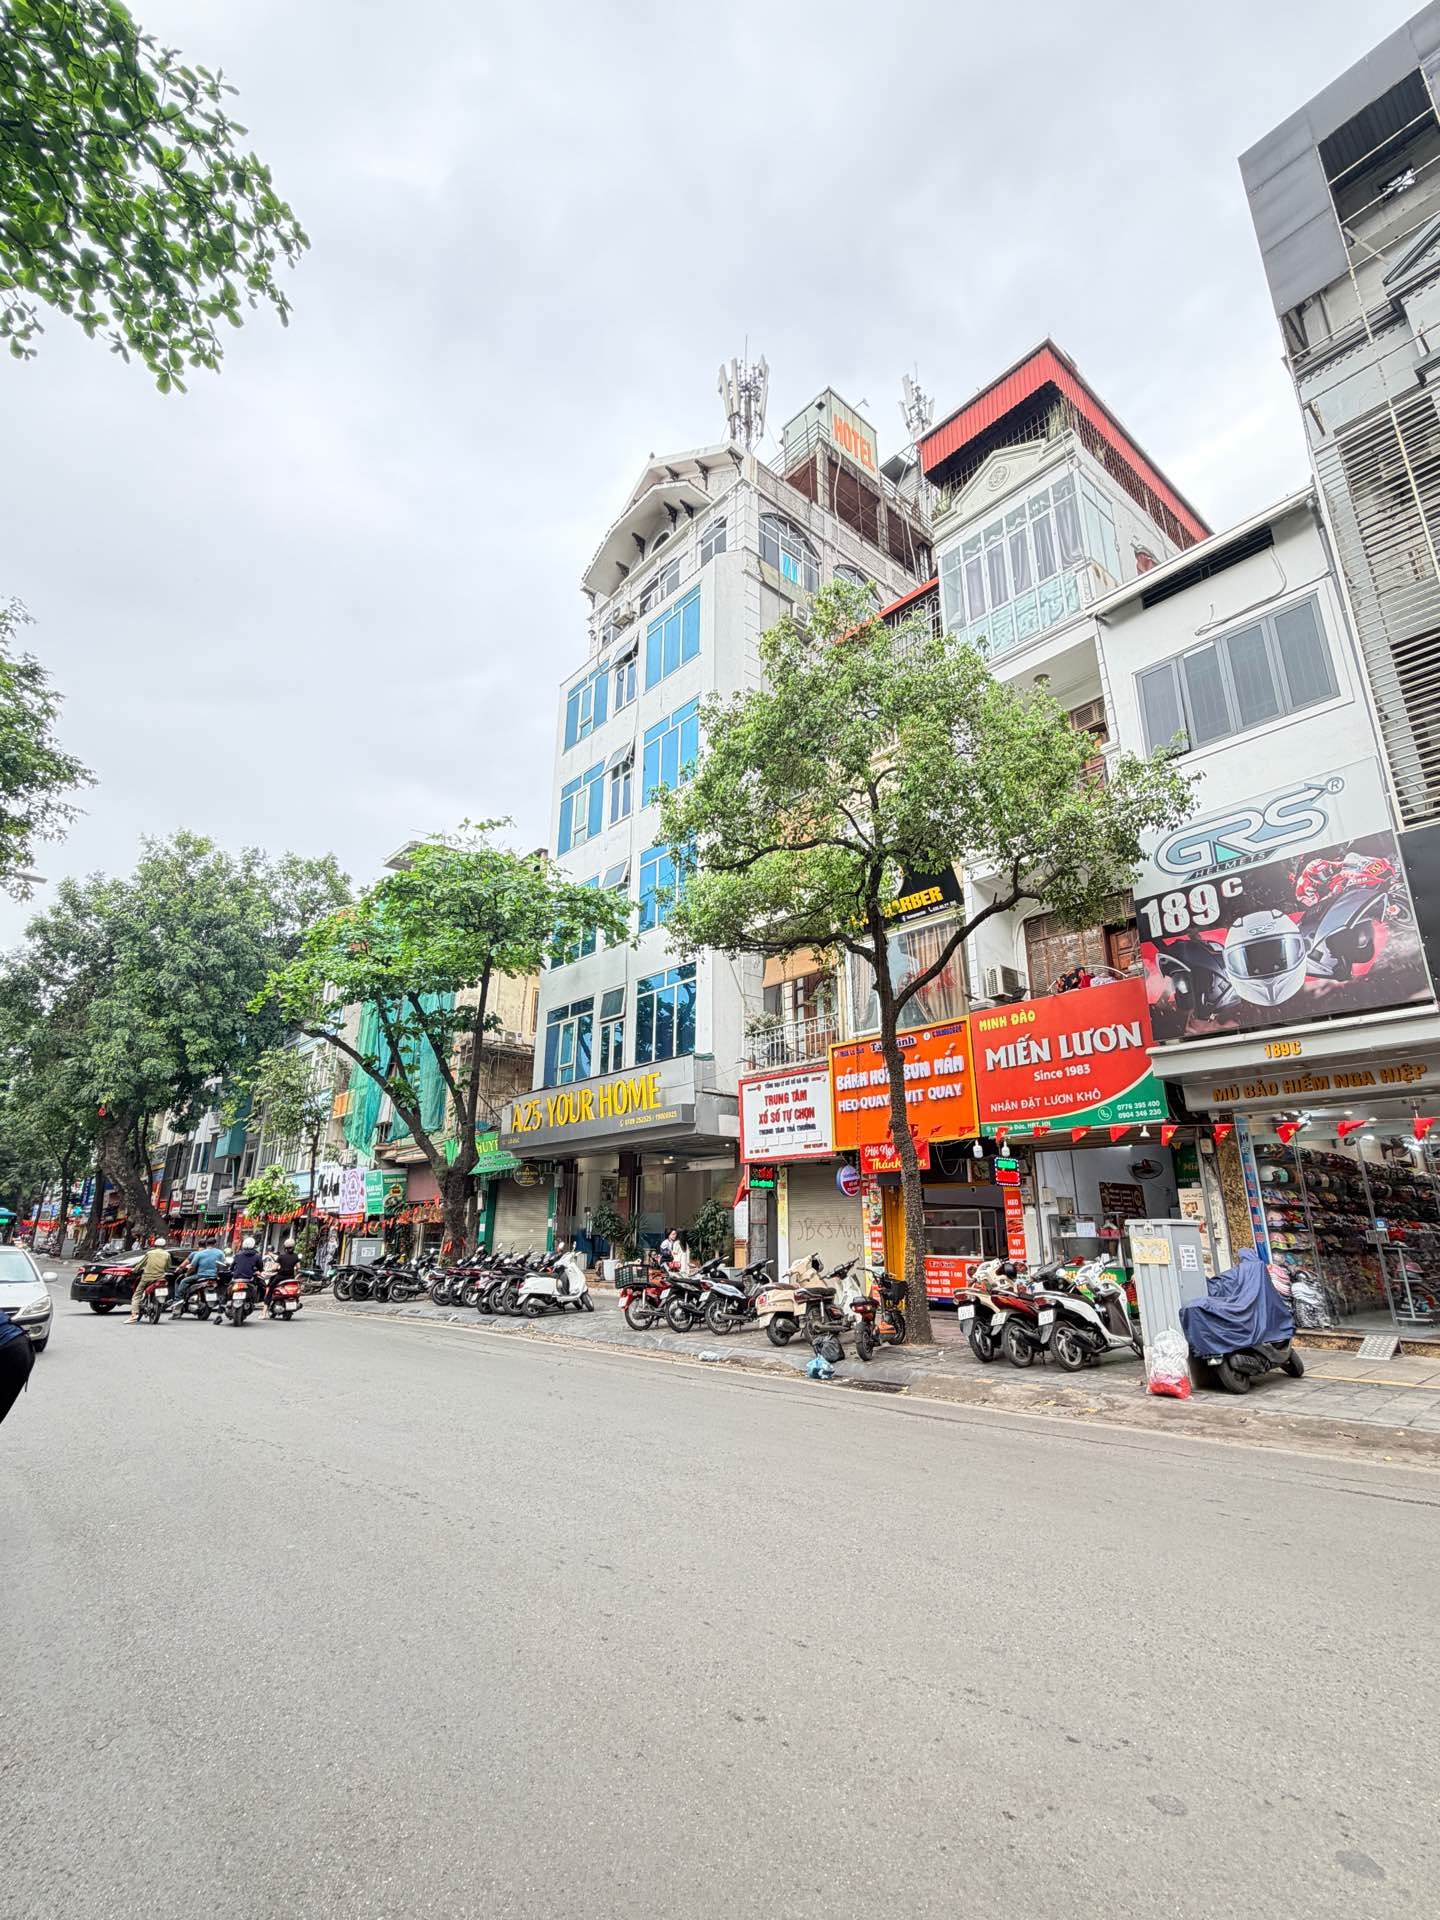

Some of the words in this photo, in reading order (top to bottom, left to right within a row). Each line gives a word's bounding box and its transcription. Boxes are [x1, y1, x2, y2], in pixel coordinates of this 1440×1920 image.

[834, 413, 875, 472] HOTEL
[1154, 782, 1329, 876] GRS
[1188, 851, 1268, 880] HELMETS
[979, 1016, 1007, 1032] MINH
[1011, 1010, 1036, 1026] ĐÀO
[985, 1033, 1051, 1071] MIẾN
[1059, 1021, 1143, 1059] LƯƠN
[1264, 1040, 1302, 1058] 189C
[836, 1067, 869, 1091] BÁNH
[870, 1061, 891, 1086] HỎ
[903, 1054, 931, 1081] BÚN
[933, 1043, 965, 1075] MẮM
[1034, 1067, 1062, 1082] Since
[1065, 1064, 1091, 1078] 1983
[1334, 1071, 1376, 1088] NGA
[1380, 1063, 1428, 1086] HIỆP
[511, 1099, 543, 1133] A25
[546, 1088, 595, 1128] YOUR
[599, 1072, 663, 1118] HOME
[764, 1092, 789, 1107] TRUNG
[791, 1088, 808, 1102] TÂM
[837, 1099, 859, 1112] HEO
[860, 1094, 891, 1110] QUAY
[905, 1089, 925, 1106] VỊT
[927, 1083, 963, 1101] QUAY
[991, 1098, 1018, 1113] NHẬN
[1021, 1096, 1041, 1110] ĐẶT
[1044, 1093, 1073, 1106] LƯƠN
[1077, 1088, 1102, 1102] KHÔ
[782, 1108, 793, 1123] TỰ
[794, 1106, 815, 1122] CHỌN
